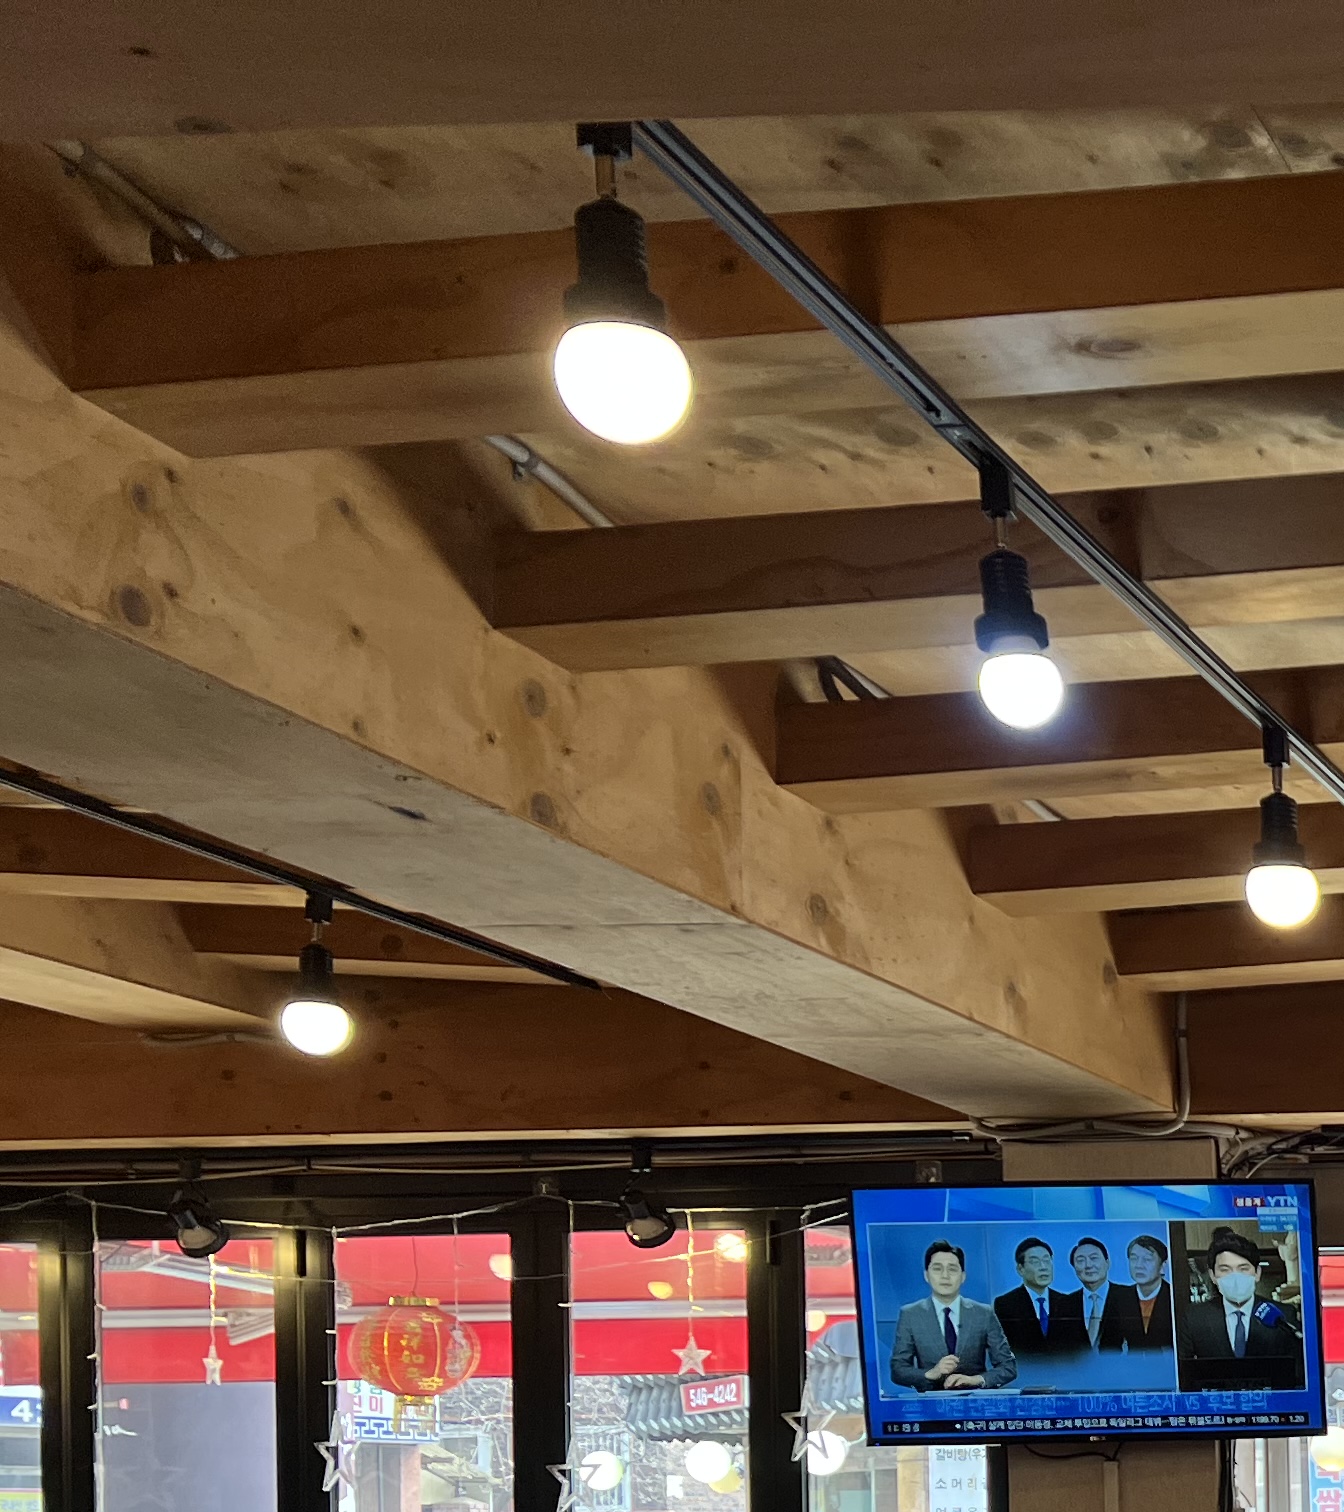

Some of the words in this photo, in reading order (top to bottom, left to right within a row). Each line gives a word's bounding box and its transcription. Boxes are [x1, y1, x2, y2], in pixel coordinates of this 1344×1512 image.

[1267, 1195, 1298, 1207] YTN
[689, 1383, 738, 1408] 546-4242
[10, 1399, 42, 1423] 4
[934, 1477, 986, 1491] 소머리
